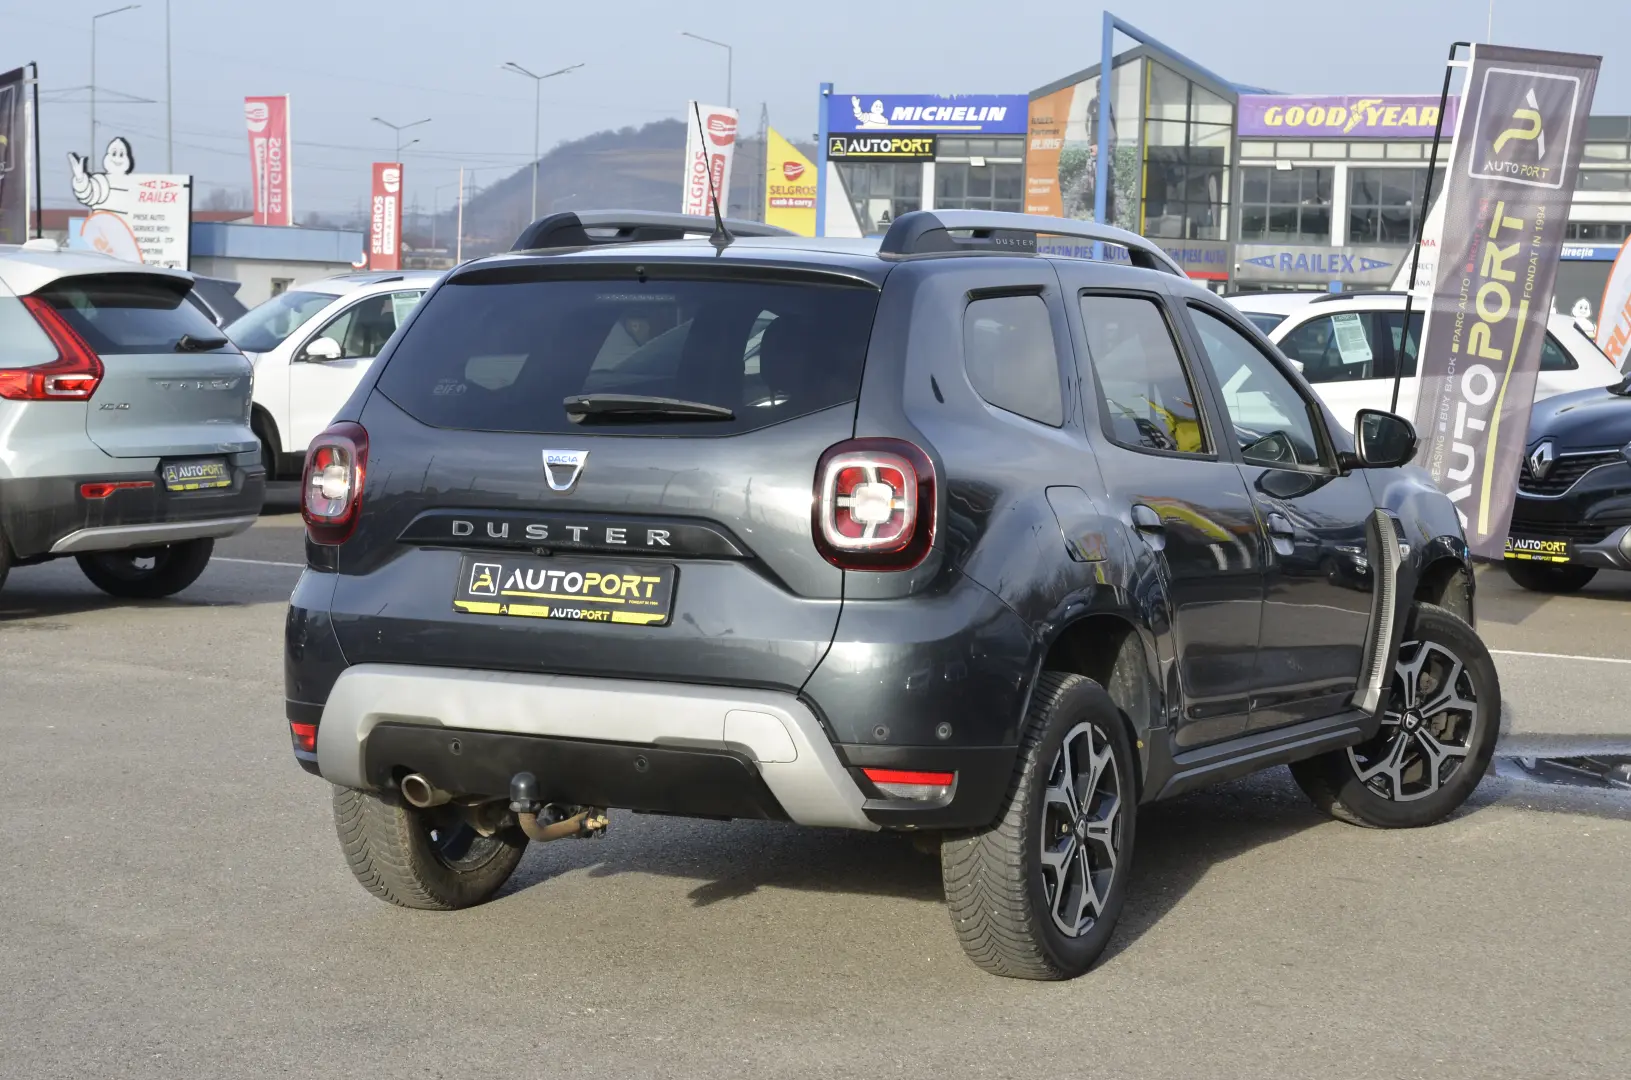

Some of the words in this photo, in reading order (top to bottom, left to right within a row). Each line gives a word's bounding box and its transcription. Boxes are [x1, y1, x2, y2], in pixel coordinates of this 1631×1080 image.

[891, 106, 1007, 121] MICHELIN
[848, 138, 933, 153] AUTOPORT
[1484, 160, 1519, 174] AUTO
[1520, 164, 1550, 179] PORT
[139, 191, 178, 203] RAILEX
[769, 185, 816, 195] SELGROS
[372, 195, 384, 254] SELGROS
[1535, 204, 1546, 232] 1994
[995, 238, 1034, 247] DUSTER
[1532, 235, 1541, 247] IN
[1279, 253, 1355, 273] RAILEX
[1524, 250, 1539, 298] FONDAT
[1458, 278, 1471, 312] AUTO
[1453, 311, 1465, 343] PARC
[1445, 356, 1457, 393] BACK
[1439, 395, 1449, 421] BUY
[547, 455, 578, 463] DACIA
[179, 464, 224, 478] AUTOPORT
[452, 520, 671, 546] DUSTER
[1514, 539, 1567, 552] AUTOPORT
[504, 568, 661, 597] AUTOPORT
[550, 608, 610, 621] AUTOPORT
